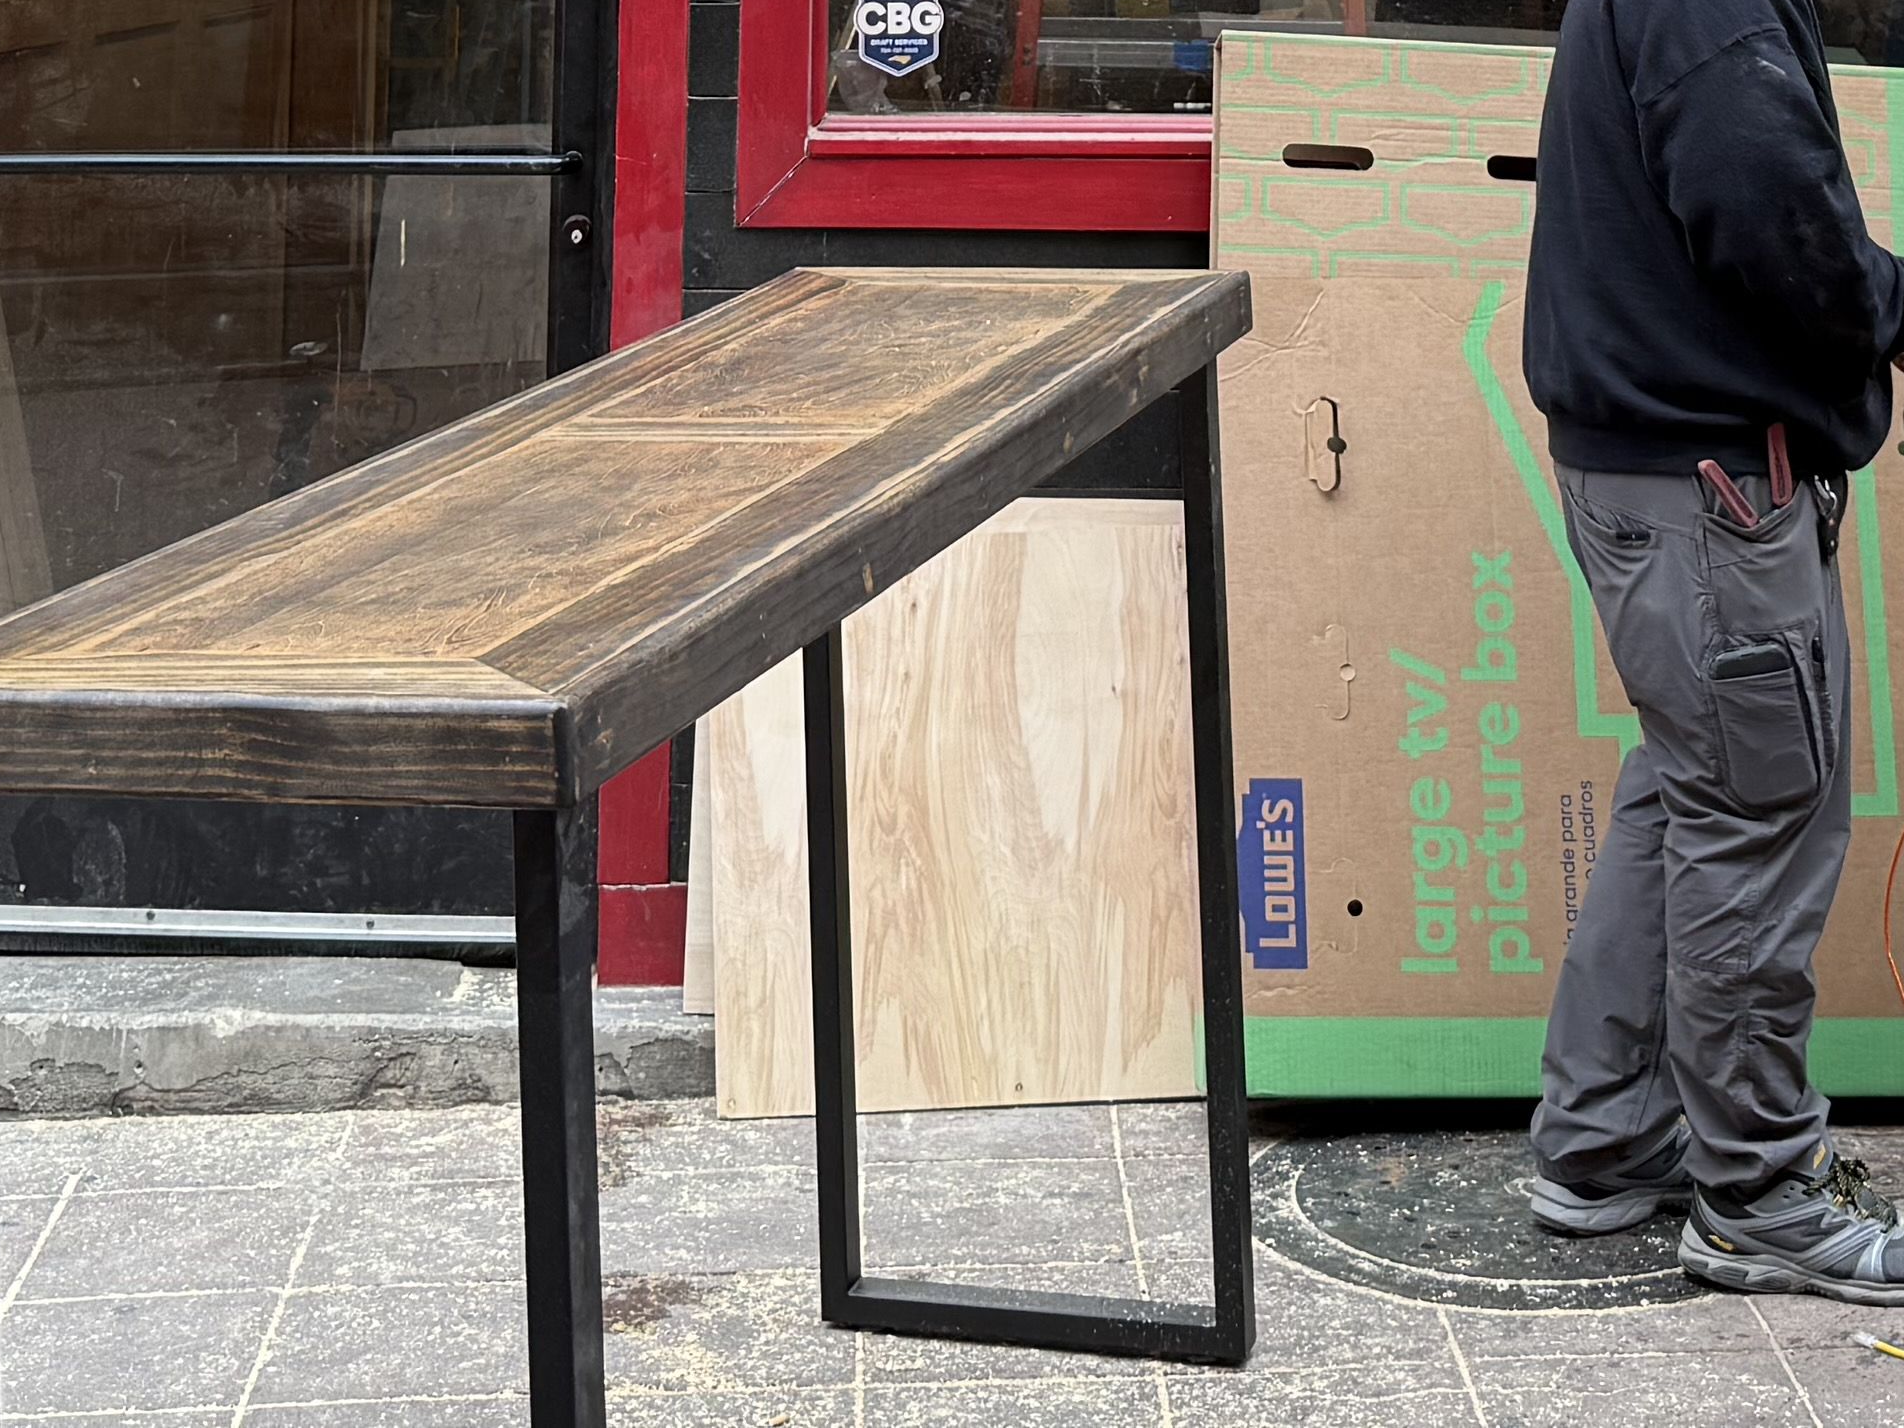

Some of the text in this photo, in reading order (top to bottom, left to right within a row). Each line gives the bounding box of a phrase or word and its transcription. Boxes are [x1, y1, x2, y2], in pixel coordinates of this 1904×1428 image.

[857, 1, 942, 35] CBG
[1388, 648, 1469, 973] large tv/
[1460, 549, 1545, 973] picture box
[1560, 794, 1577, 842] para
[1258, 797, 1298, 949] LOWE'S
[1578, 780, 1596, 863] cuadros
